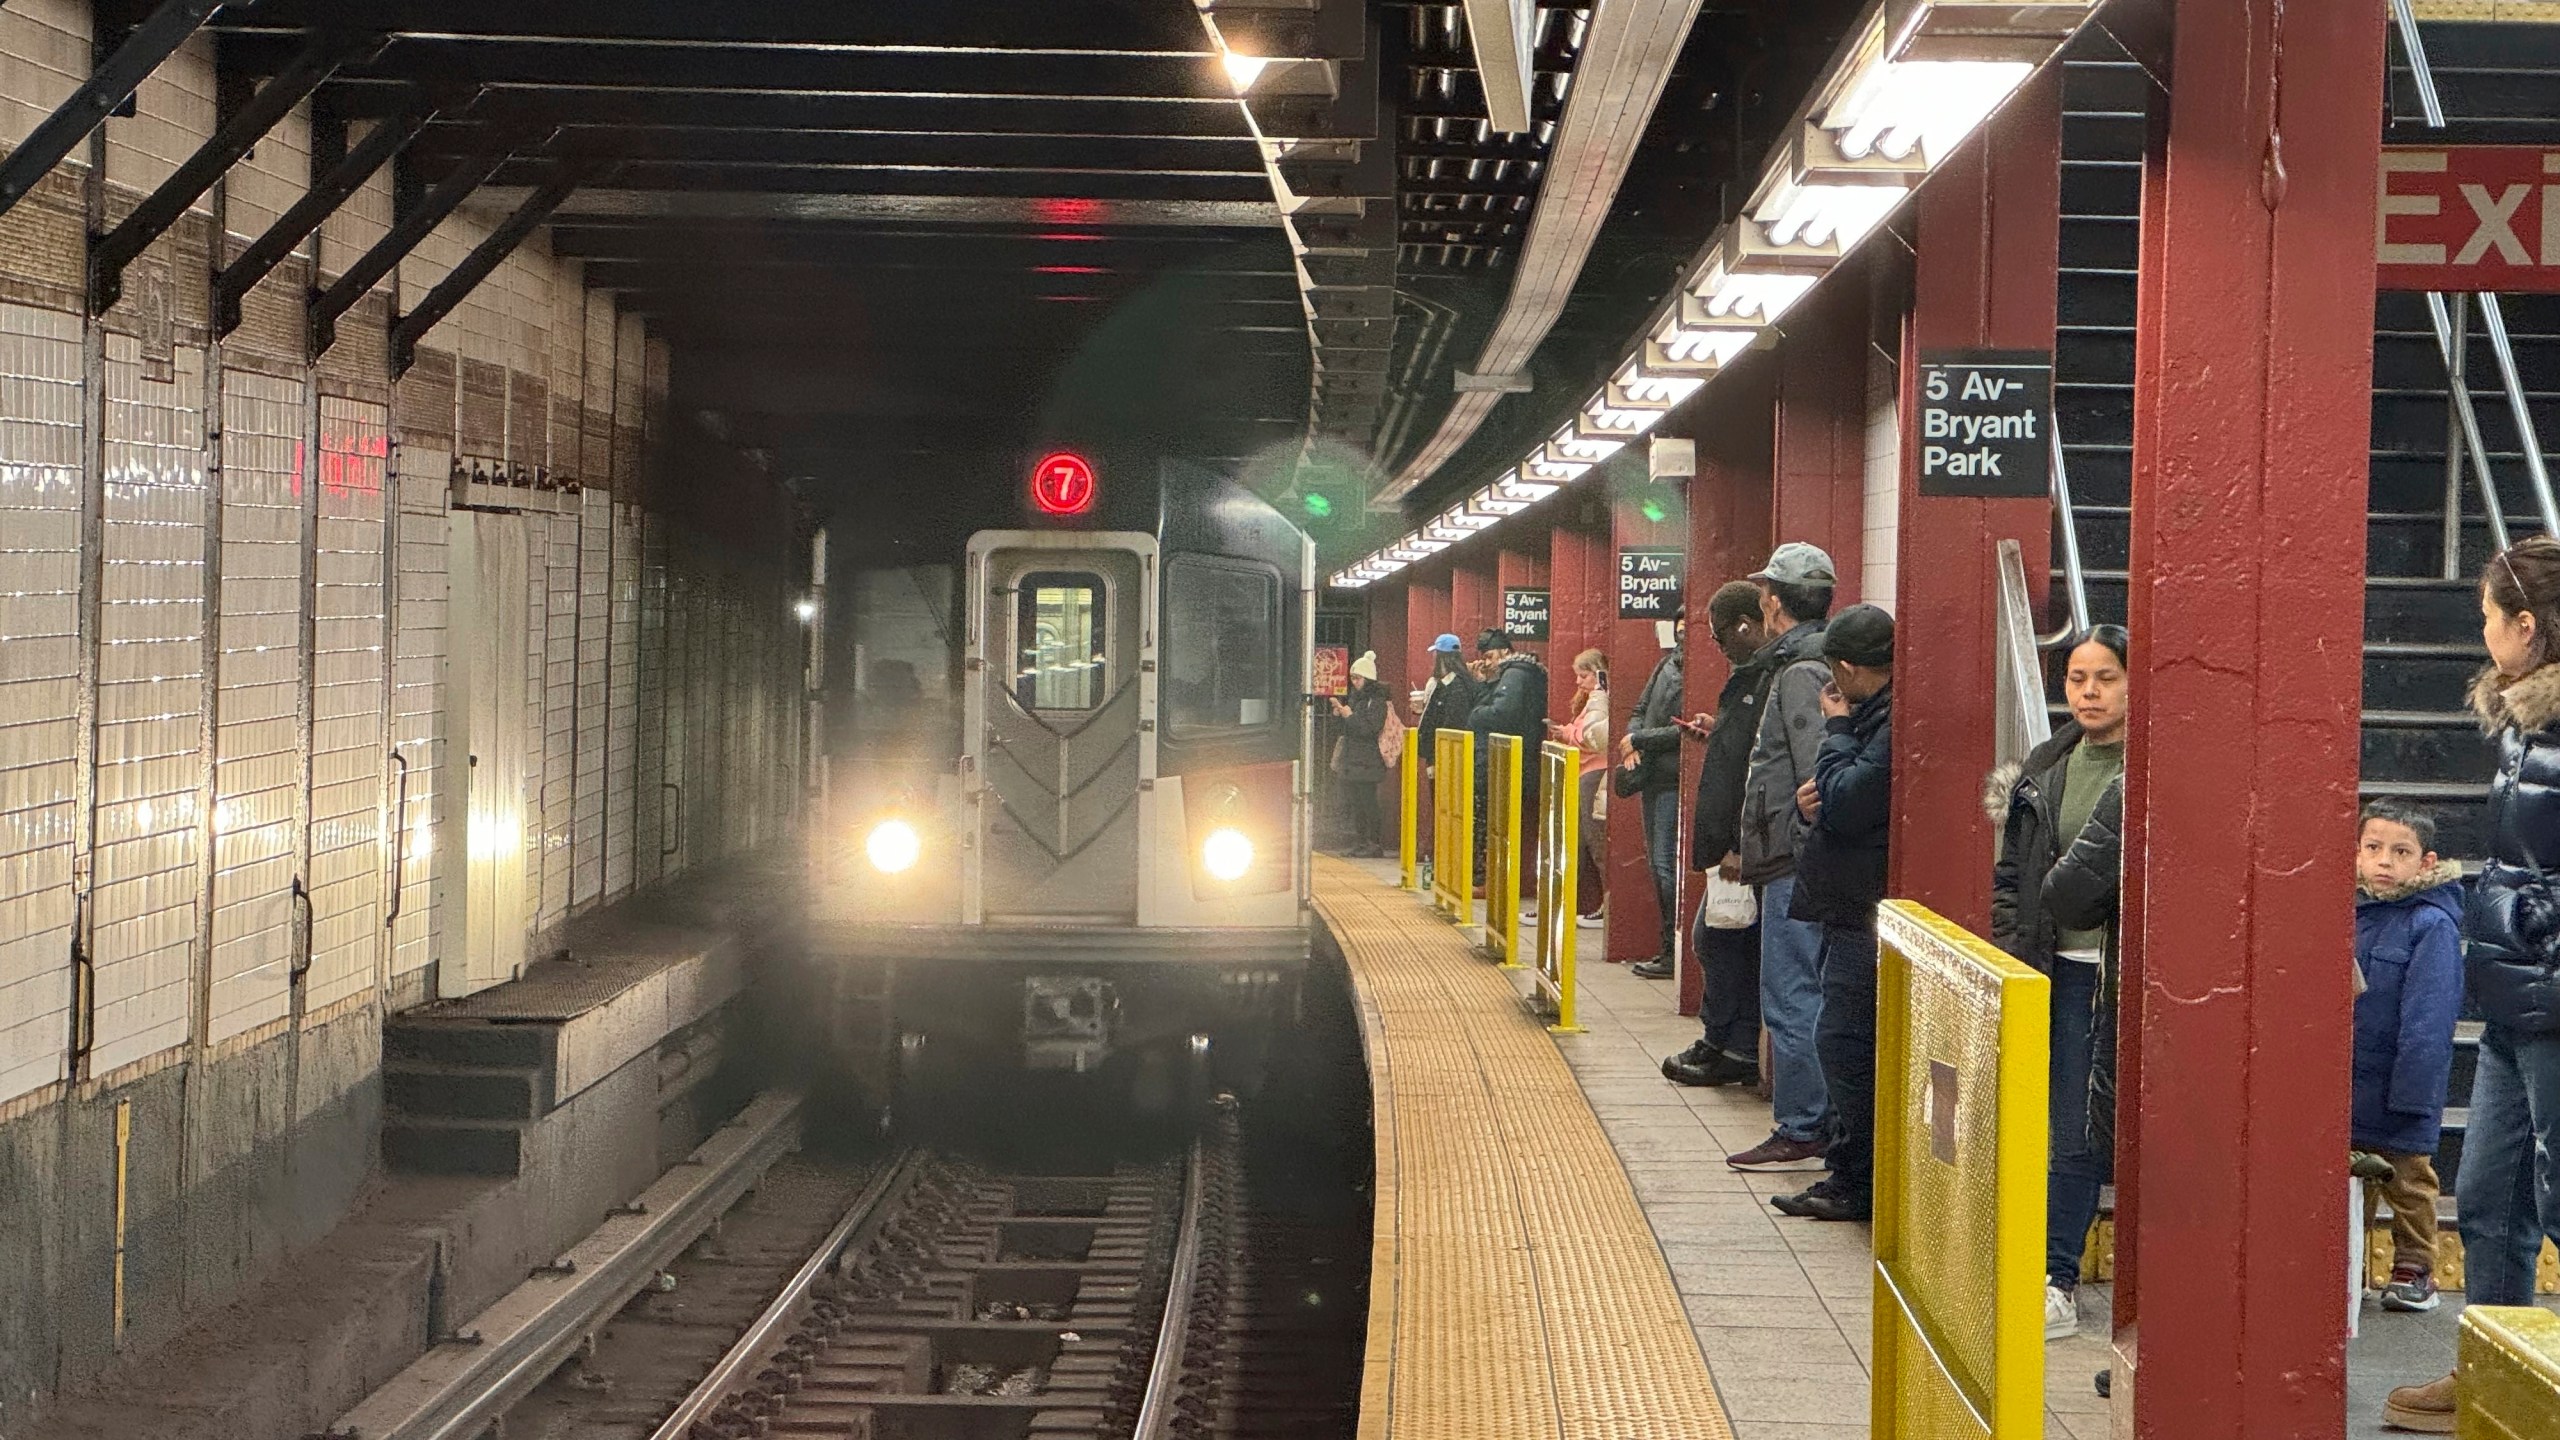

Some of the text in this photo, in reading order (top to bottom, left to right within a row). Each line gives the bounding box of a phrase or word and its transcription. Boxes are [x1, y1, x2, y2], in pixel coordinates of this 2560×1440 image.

[1925, 370, 2024, 401] 5 Av-
[1924, 408, 2036, 445] Bryant
[1924, 446, 2002, 476] Park
[1053, 466, 1074, 501] 7
[1621, 555, 1670, 572] 5 Av-
[1621, 574, 1677, 593] Bryant
[1505, 593, 1516, 606] 5
[1621, 593, 1660, 609] Park
[1505, 607, 1548, 622] Bryant
[1505, 621, 1535, 635] Park
